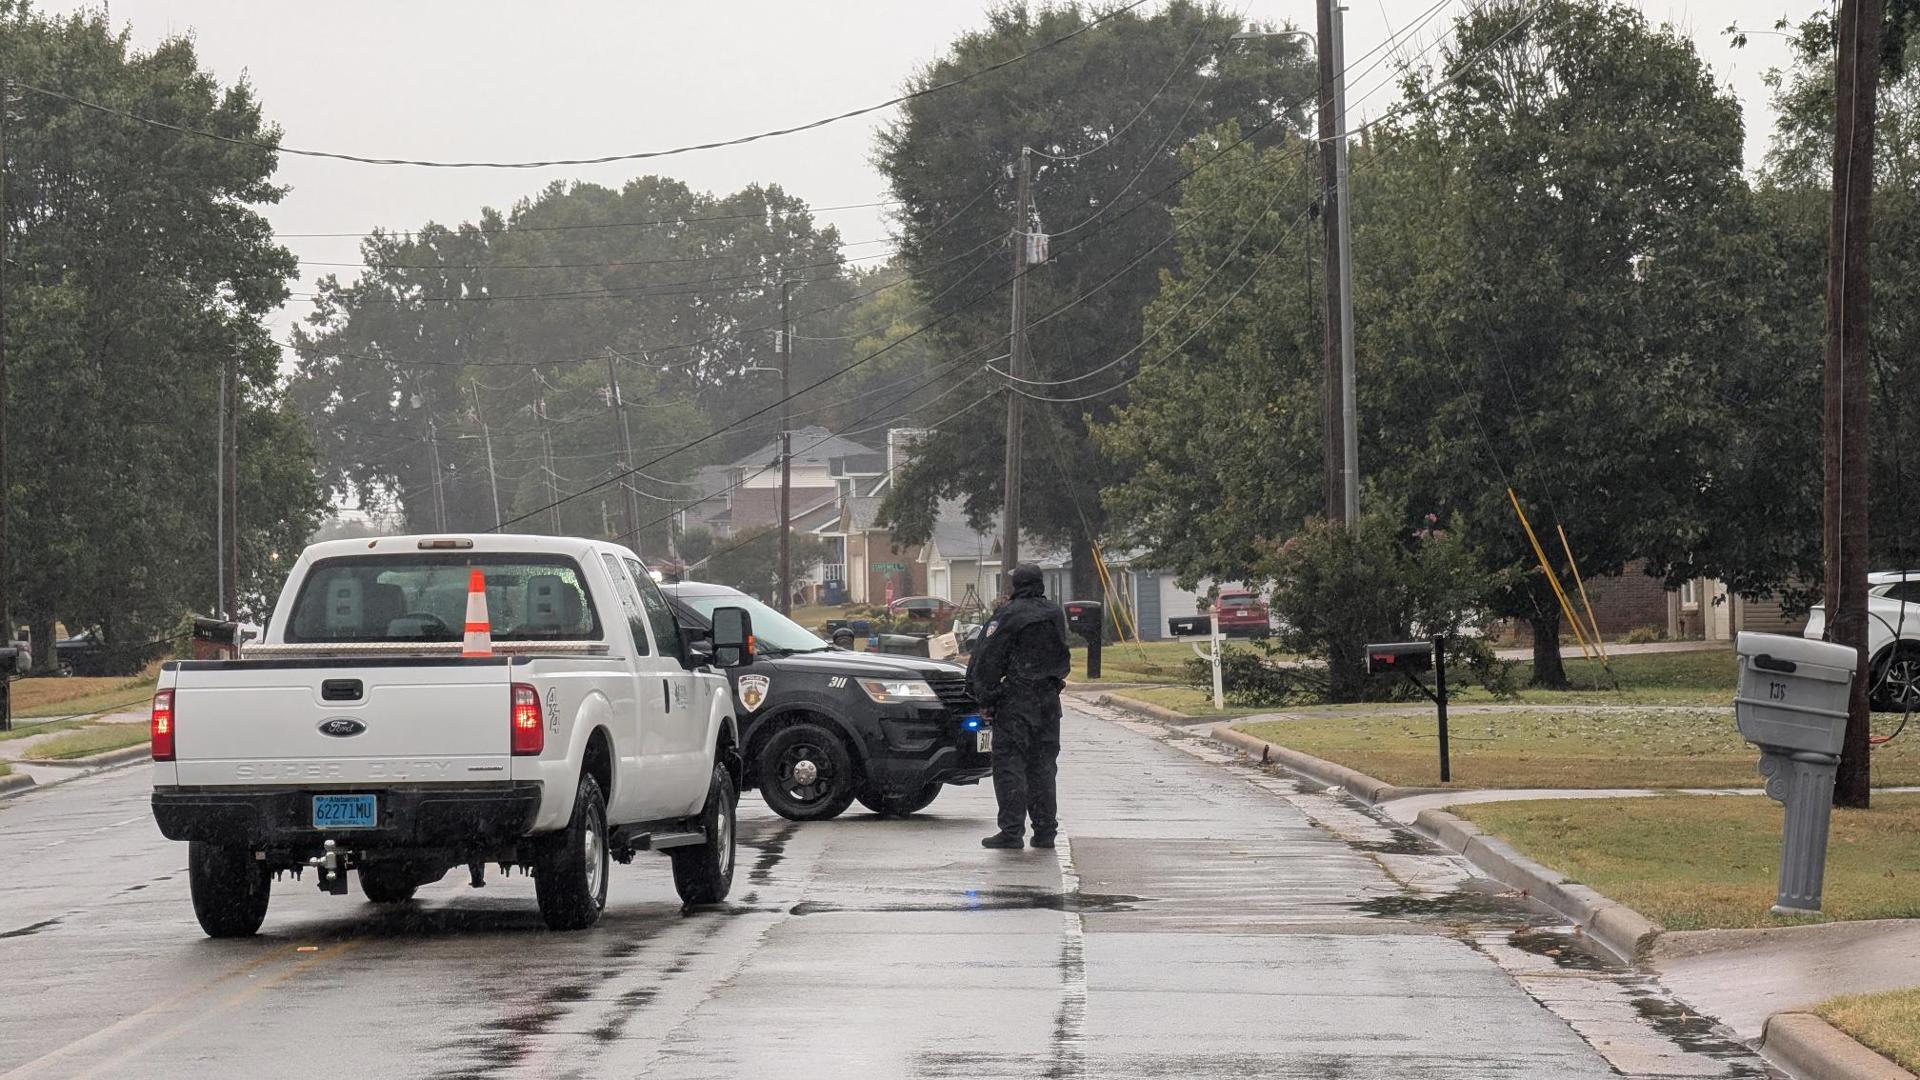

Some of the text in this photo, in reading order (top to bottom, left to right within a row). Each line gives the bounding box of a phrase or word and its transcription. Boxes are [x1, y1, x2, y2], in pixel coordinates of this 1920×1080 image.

[828, 676, 848, 688] 311
[328, 721, 354, 732] Ford
[236, 761, 452, 780] SUPER DUTY
[316, 803, 371, 819] 62271MU
